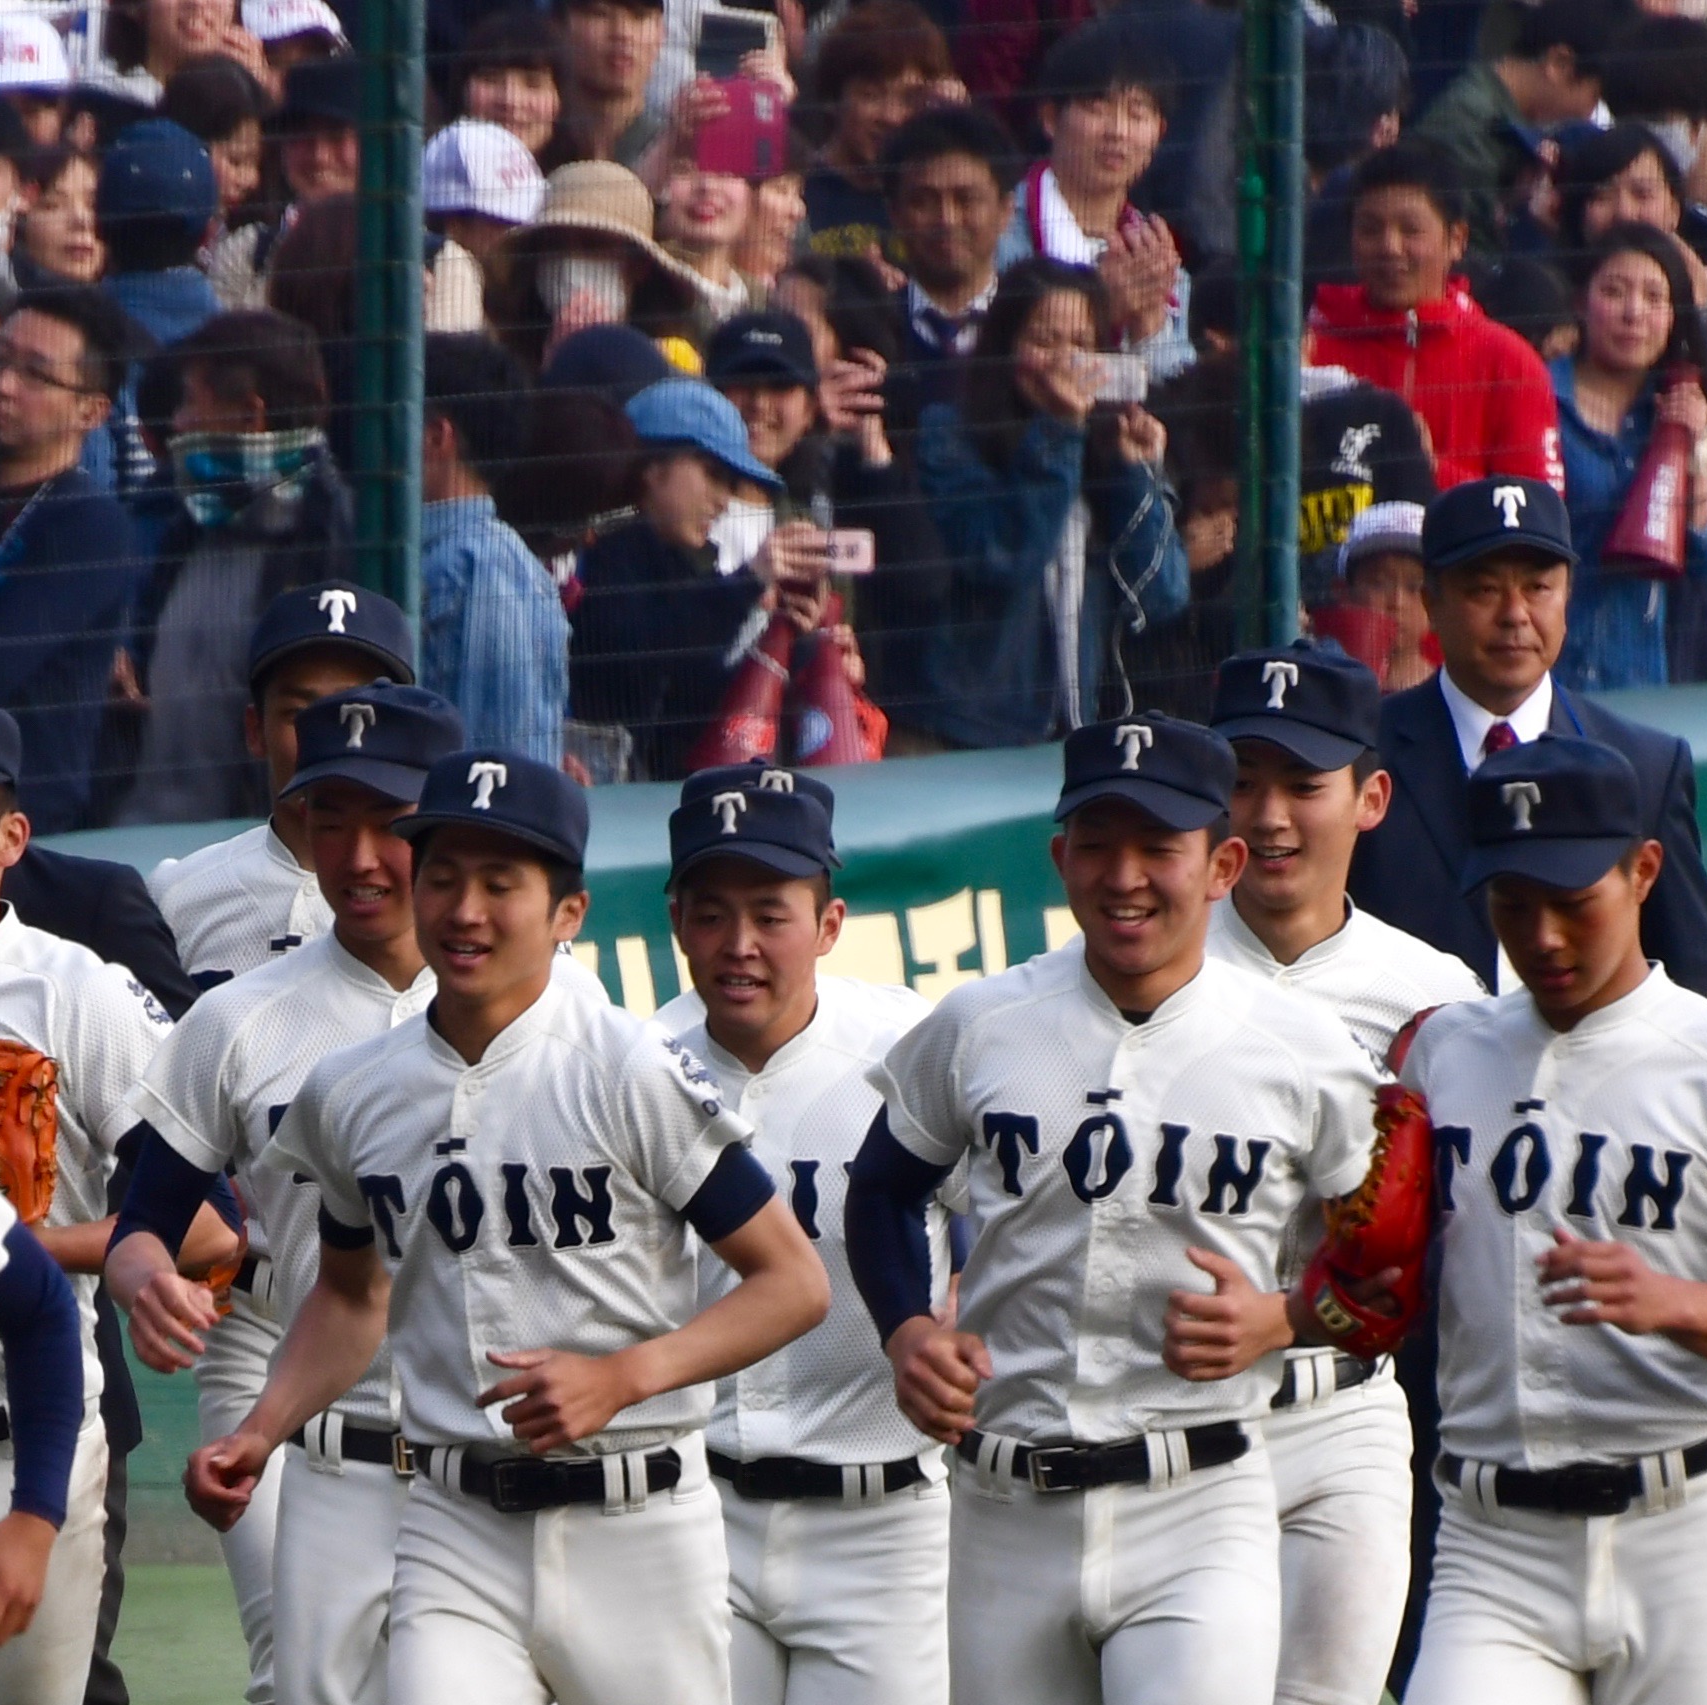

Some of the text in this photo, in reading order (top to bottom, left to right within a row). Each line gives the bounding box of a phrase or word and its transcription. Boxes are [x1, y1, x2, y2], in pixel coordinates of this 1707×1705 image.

[1493, 485, 1527, 528] T
[319, 589, 357, 634] T
[1262, 660, 1299, 710] T
[340, 703, 377, 750] T
[1115, 723, 1153, 771] T
[467, 761, 507, 810] T
[1502, 781, 1542, 832] T
[713, 791, 747, 834] T
